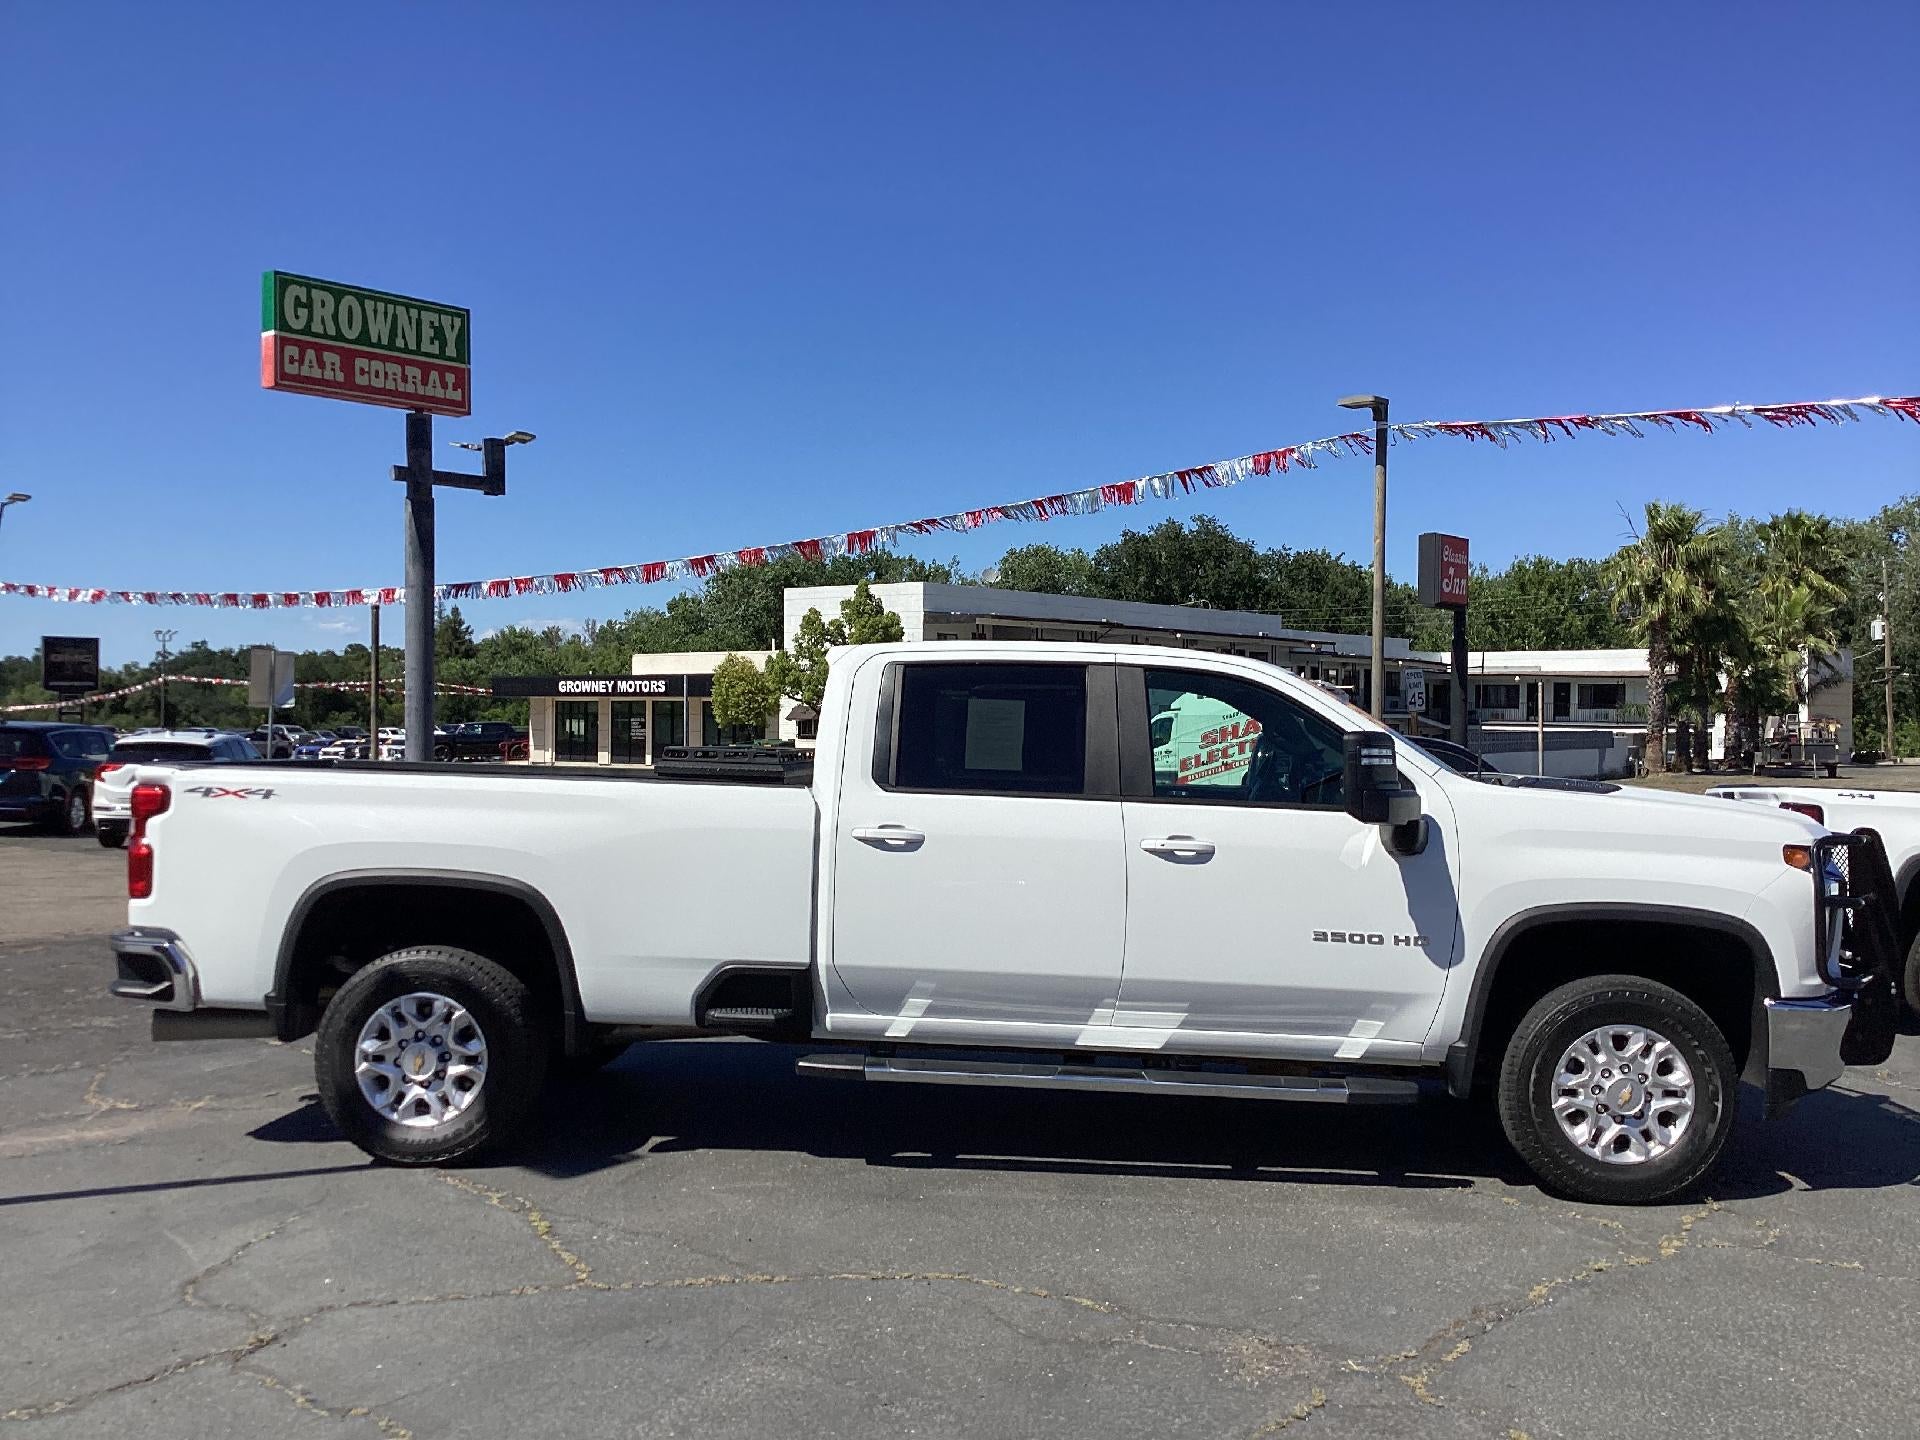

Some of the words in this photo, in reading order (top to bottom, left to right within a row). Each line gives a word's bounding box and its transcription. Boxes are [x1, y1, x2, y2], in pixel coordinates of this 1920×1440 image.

[283, 283, 462, 358] GROWNEY
[283, 345, 345, 383] CAR
[354, 357, 462, 401] CORRAL
[1442, 566, 1467, 595] Inn
[558, 680, 615, 693] GROWNEY
[617, 680, 666, 693] MOTORS
[1408, 691, 1425, 707] 45
[1312, 930, 1385, 946] 3500
[1393, 934, 1431, 947] HD
